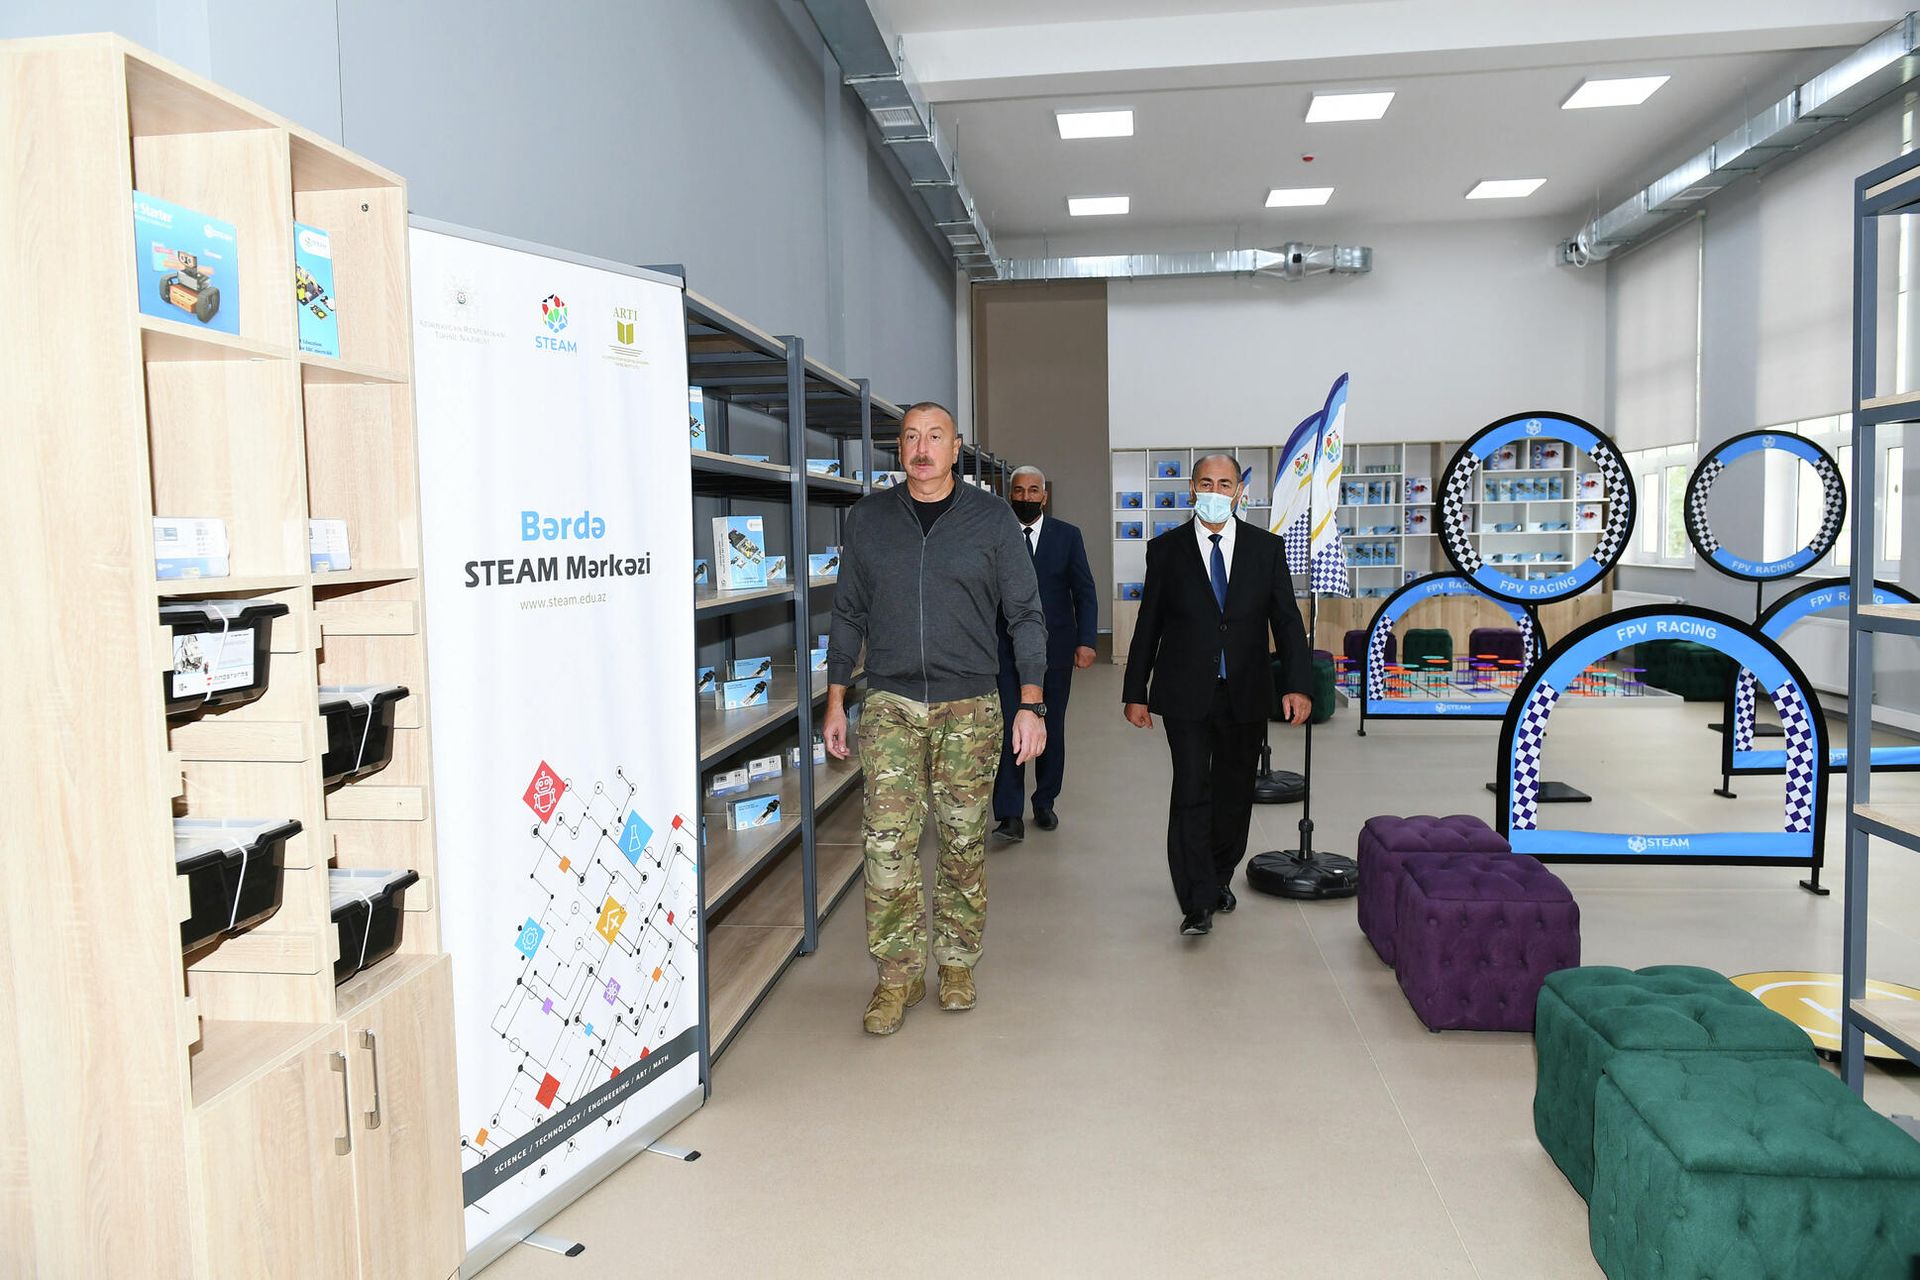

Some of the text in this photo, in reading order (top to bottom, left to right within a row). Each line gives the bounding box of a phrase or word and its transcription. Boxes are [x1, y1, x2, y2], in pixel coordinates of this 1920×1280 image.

[535, 335, 577, 353] STEAM
[521, 510, 606, 541] Bərdə
[464, 551, 651, 588] STEAM Mərkəzi
[1732, 560, 1796, 574] FPV RACING
[1426, 582, 1444, 593] FPV
[1500, 576, 1578, 595] FPV RACING
[520, 592, 607, 610] www.steam.edu.az
[1810, 593, 1833, 608] FPV
[1616, 621, 1717, 641] FPV RACING
[1647, 837, 1690, 848] STEAM
[494, 1148, 527, 1175] SCIENCE
[535, 1112, 581, 1148] TECHNOLOGY
[588, 1080, 630, 1113] ENGINEERING
[635, 1068, 648, 1081] ART
[652, 1054, 669, 1069] MATH
